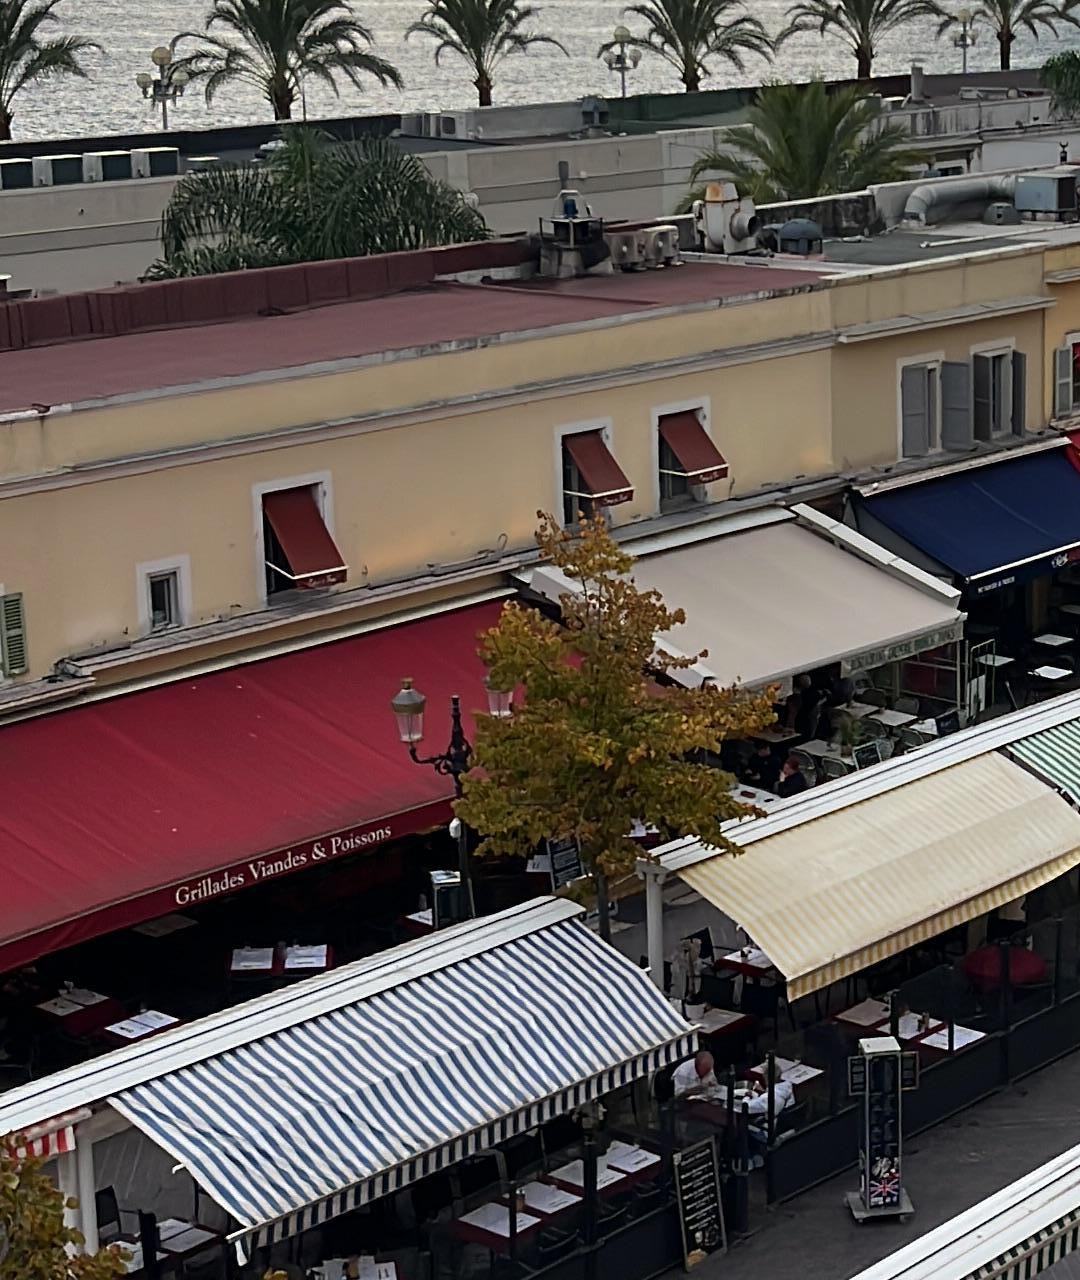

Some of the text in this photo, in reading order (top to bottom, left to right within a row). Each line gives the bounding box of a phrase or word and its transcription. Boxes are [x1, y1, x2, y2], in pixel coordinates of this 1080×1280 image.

[175, 825, 392, 905] Grillades Viandes & Poissons
